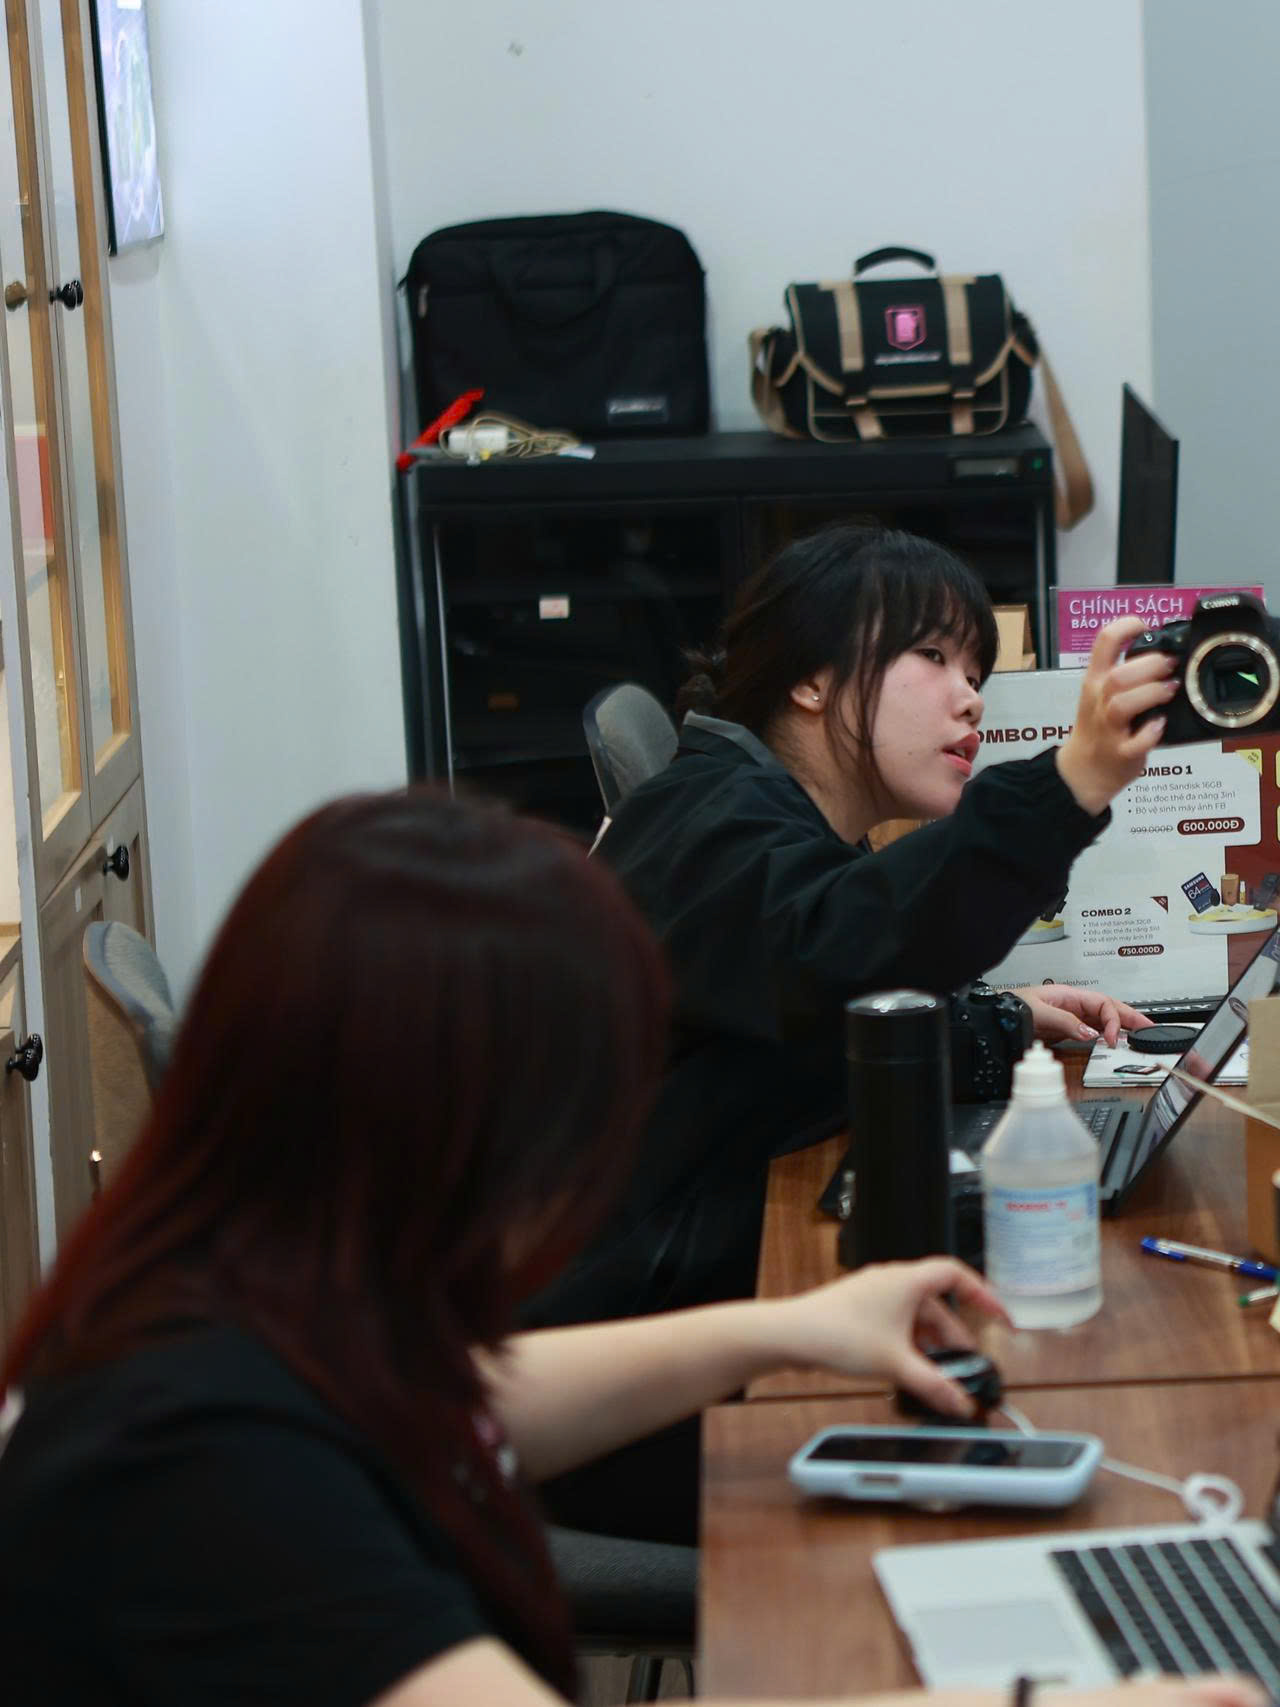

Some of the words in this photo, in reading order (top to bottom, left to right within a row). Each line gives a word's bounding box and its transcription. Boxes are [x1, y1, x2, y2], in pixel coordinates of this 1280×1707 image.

[1069, 595, 1129, 615] CHÍNH
[1135, 593, 1183, 613] SÁCH
[1202, 596, 1240, 609] Canon
[1071, 616, 1098, 629] BẢO
[978, 727, 1038, 744] MBO
[1041, 725, 1073, 741] PH
[1139, 765, 1183, 778] OMBO
[1185, 765, 1193, 775] 1
[1169, 782, 1200, 791] Sandisk
[1182, 820, 1240, 832] 600.000Đ
[1187, 886, 1201, 900] 64
[1081, 908, 1123, 918] COMBO
[1124, 907, 1132, 915] 2
[1121, 946, 1160, 955] 750.000Đ
